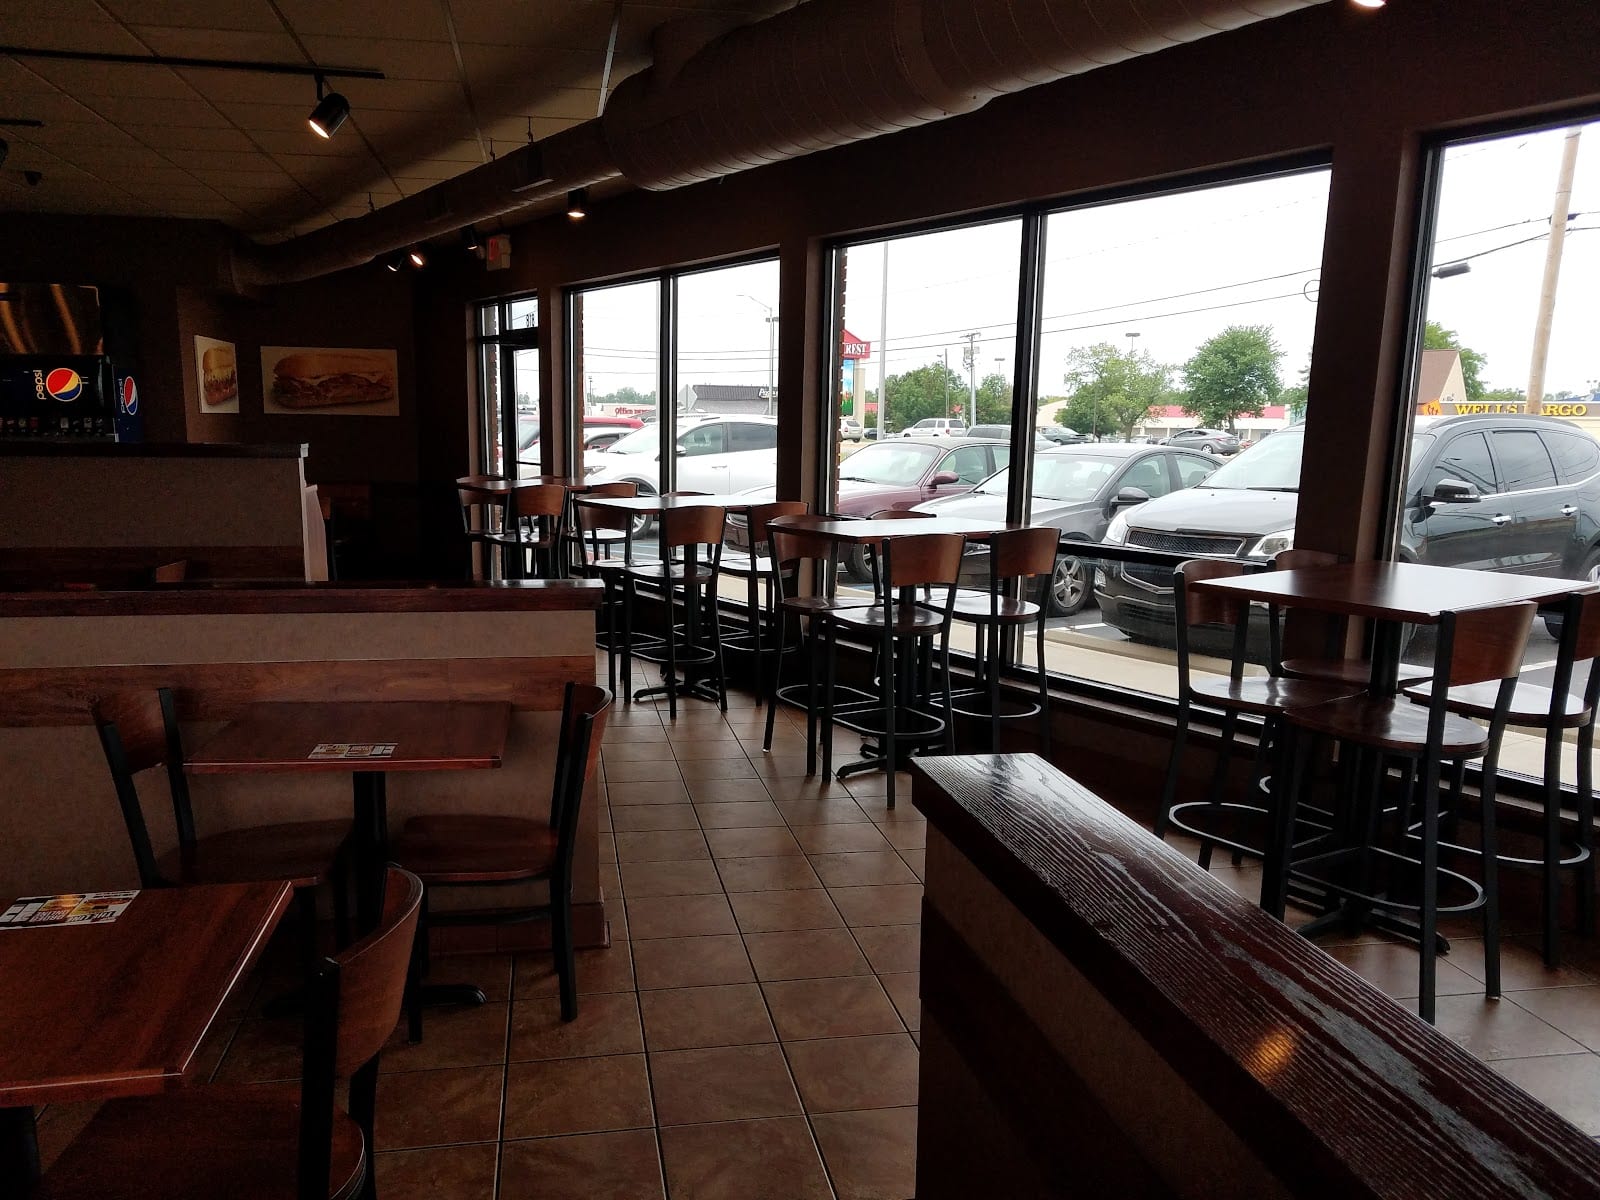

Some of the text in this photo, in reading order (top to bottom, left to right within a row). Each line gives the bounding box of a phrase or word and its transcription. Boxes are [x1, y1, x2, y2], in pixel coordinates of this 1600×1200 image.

[844, 343, 867, 355] REST
[32, 369, 47, 400] pepsi
[1455, 403, 1518, 415] WELLS
